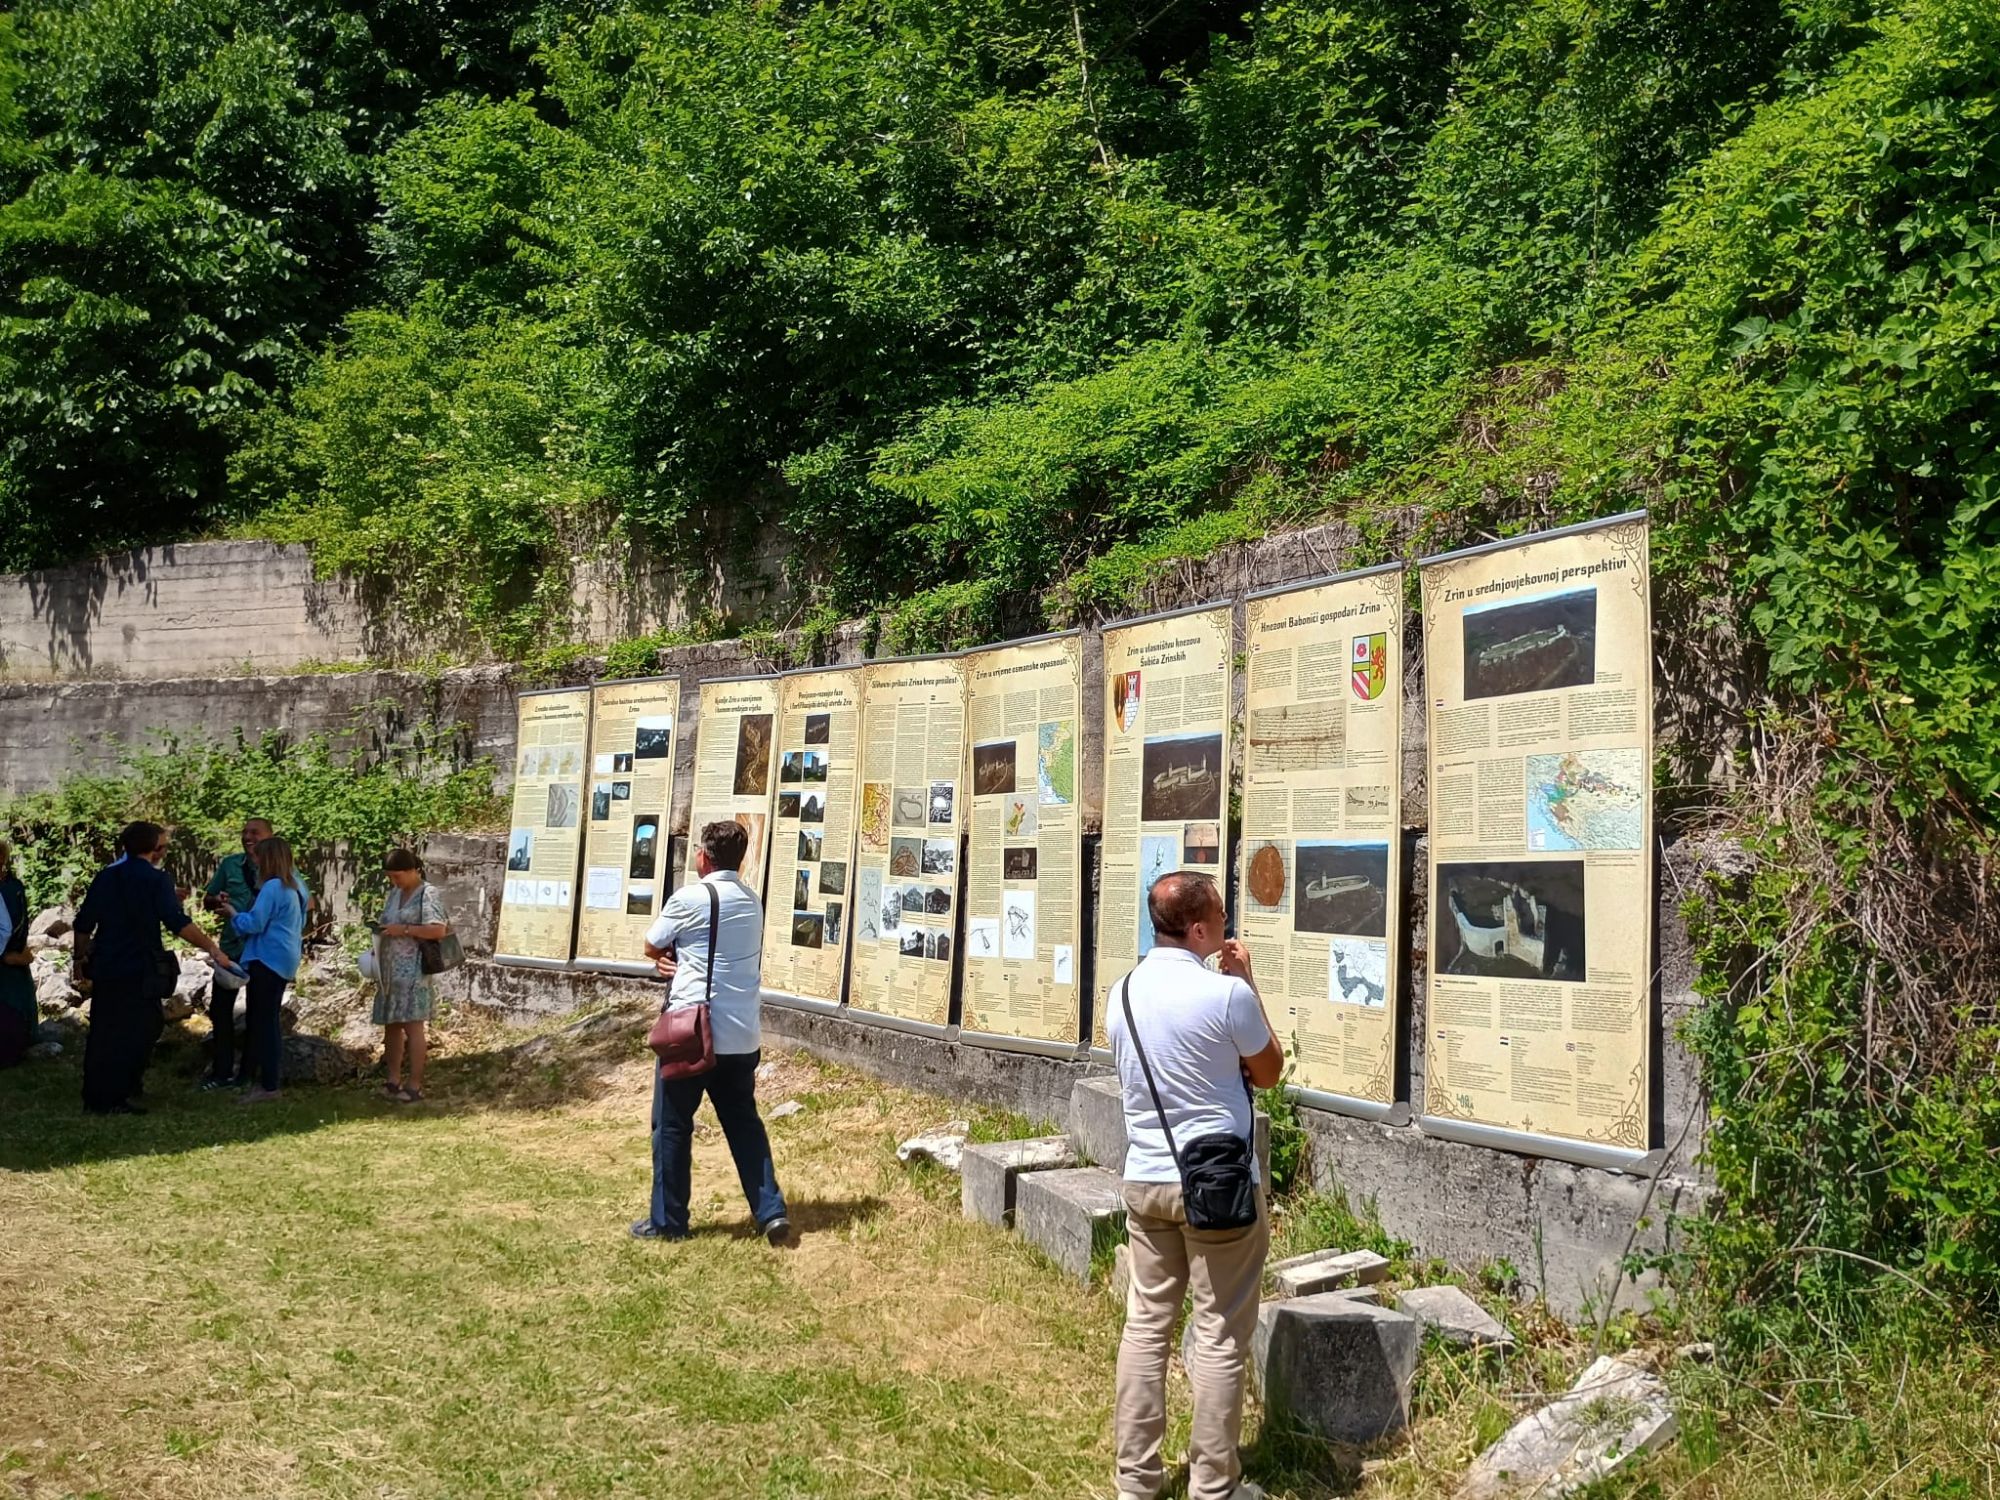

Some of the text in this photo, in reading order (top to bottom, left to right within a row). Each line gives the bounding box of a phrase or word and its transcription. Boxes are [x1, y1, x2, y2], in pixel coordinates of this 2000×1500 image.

[1444, 555, 1627, 602] Zrin u srednjovjekovnoj perspektivi
[1320, 605, 1357, 624] gospodari
[1359, 602, 1381, 615] Zrina
[1126, 645, 1139, 656] Zrin
